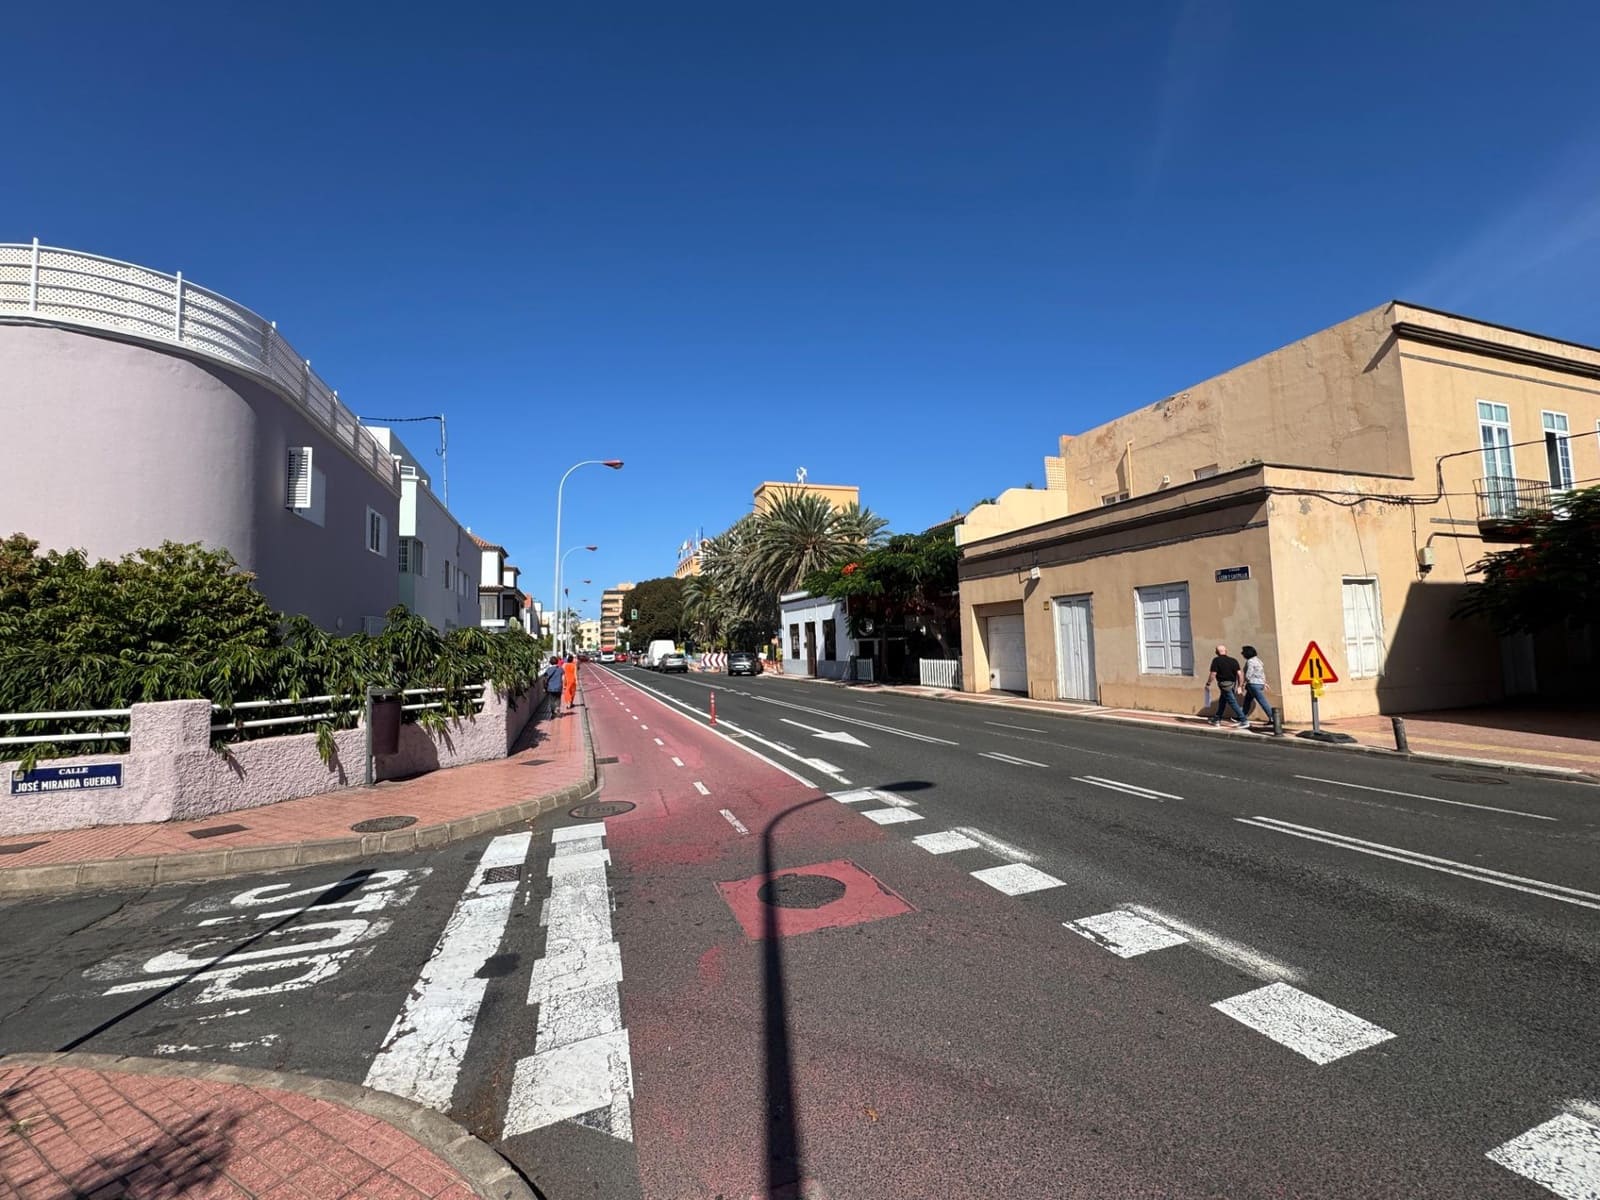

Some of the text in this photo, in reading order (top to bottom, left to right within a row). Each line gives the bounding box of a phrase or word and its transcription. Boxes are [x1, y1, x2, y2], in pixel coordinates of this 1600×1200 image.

[59, 767, 88, 775] CALLE
[16, 775, 117, 792] JOSÉ MIRANDA GUERRA
[102, 869, 410, 1003] STOP
